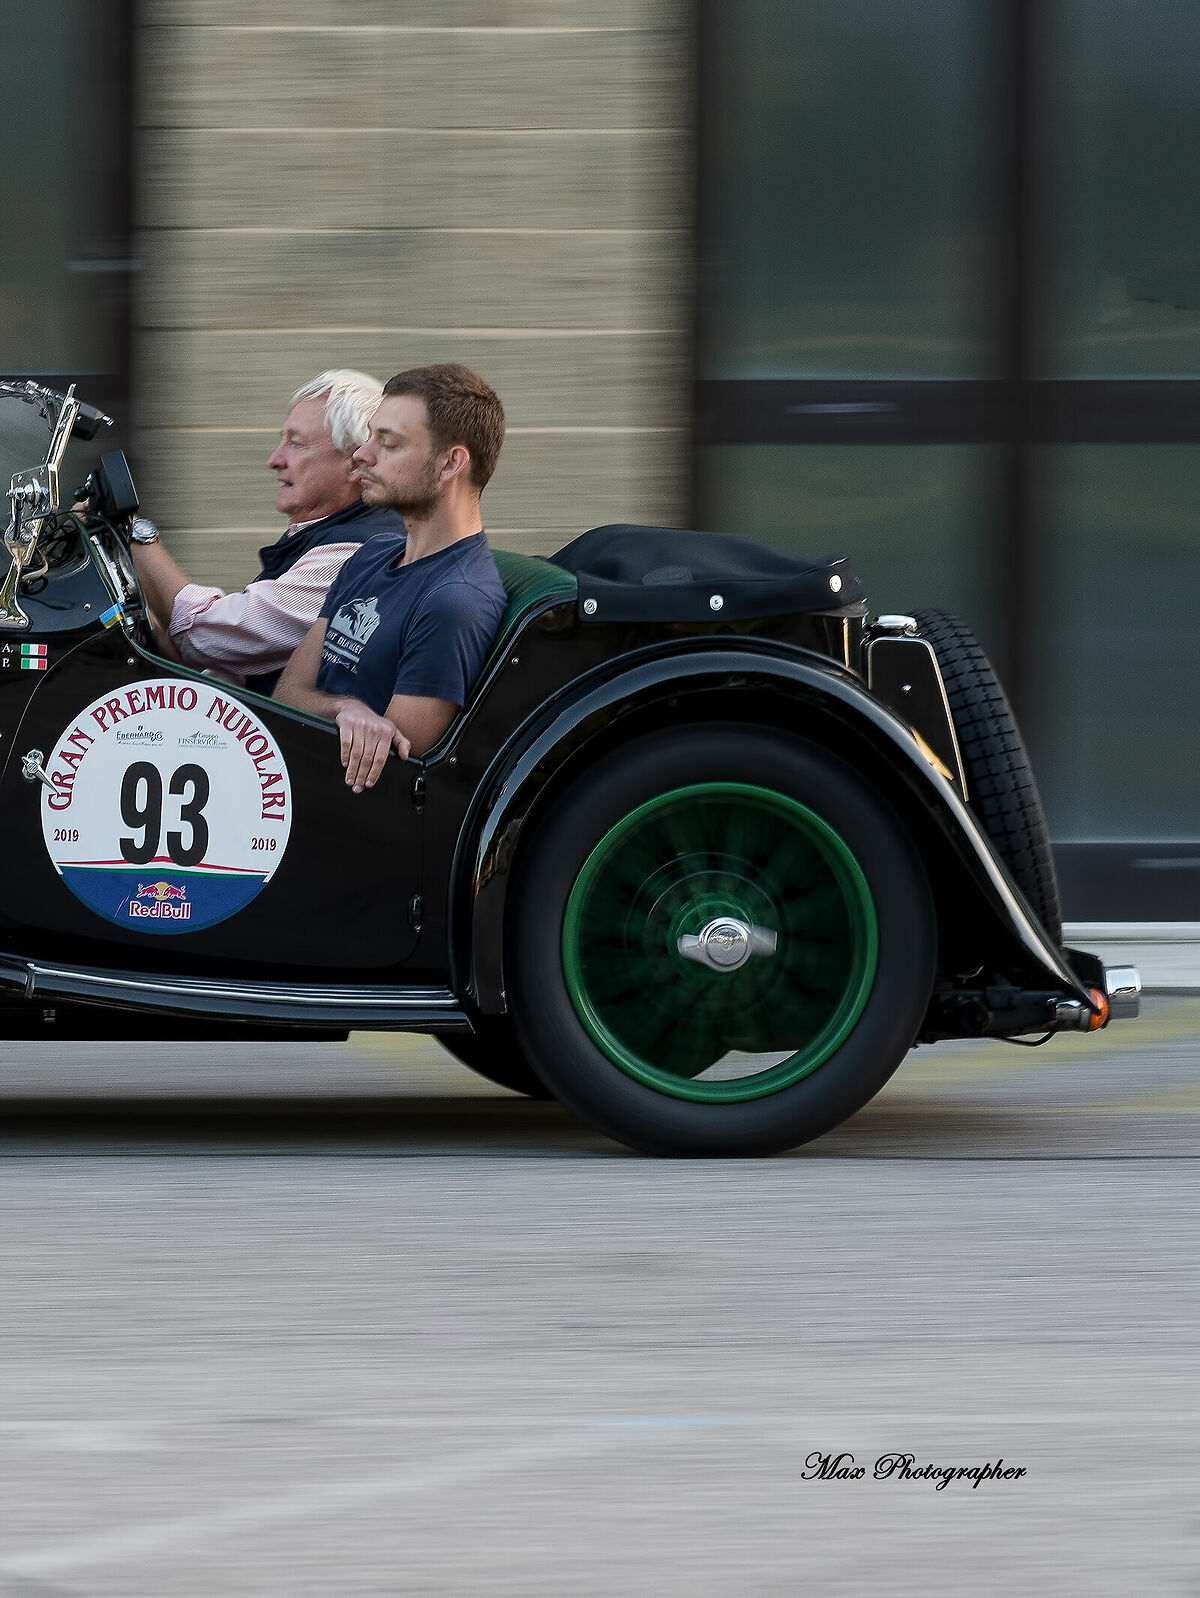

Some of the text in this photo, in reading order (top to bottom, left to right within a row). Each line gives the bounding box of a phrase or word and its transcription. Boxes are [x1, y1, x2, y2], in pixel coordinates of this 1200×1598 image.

[2, 643, 14, 653] A.
[2, 657, 11, 668] P.
[48, 685, 286, 822] GRAN PREMIO NUVOLARI
[119, 760, 210, 868] 93
[53, 828, 79, 842] 2019
[251, 837, 277, 851] 2019
